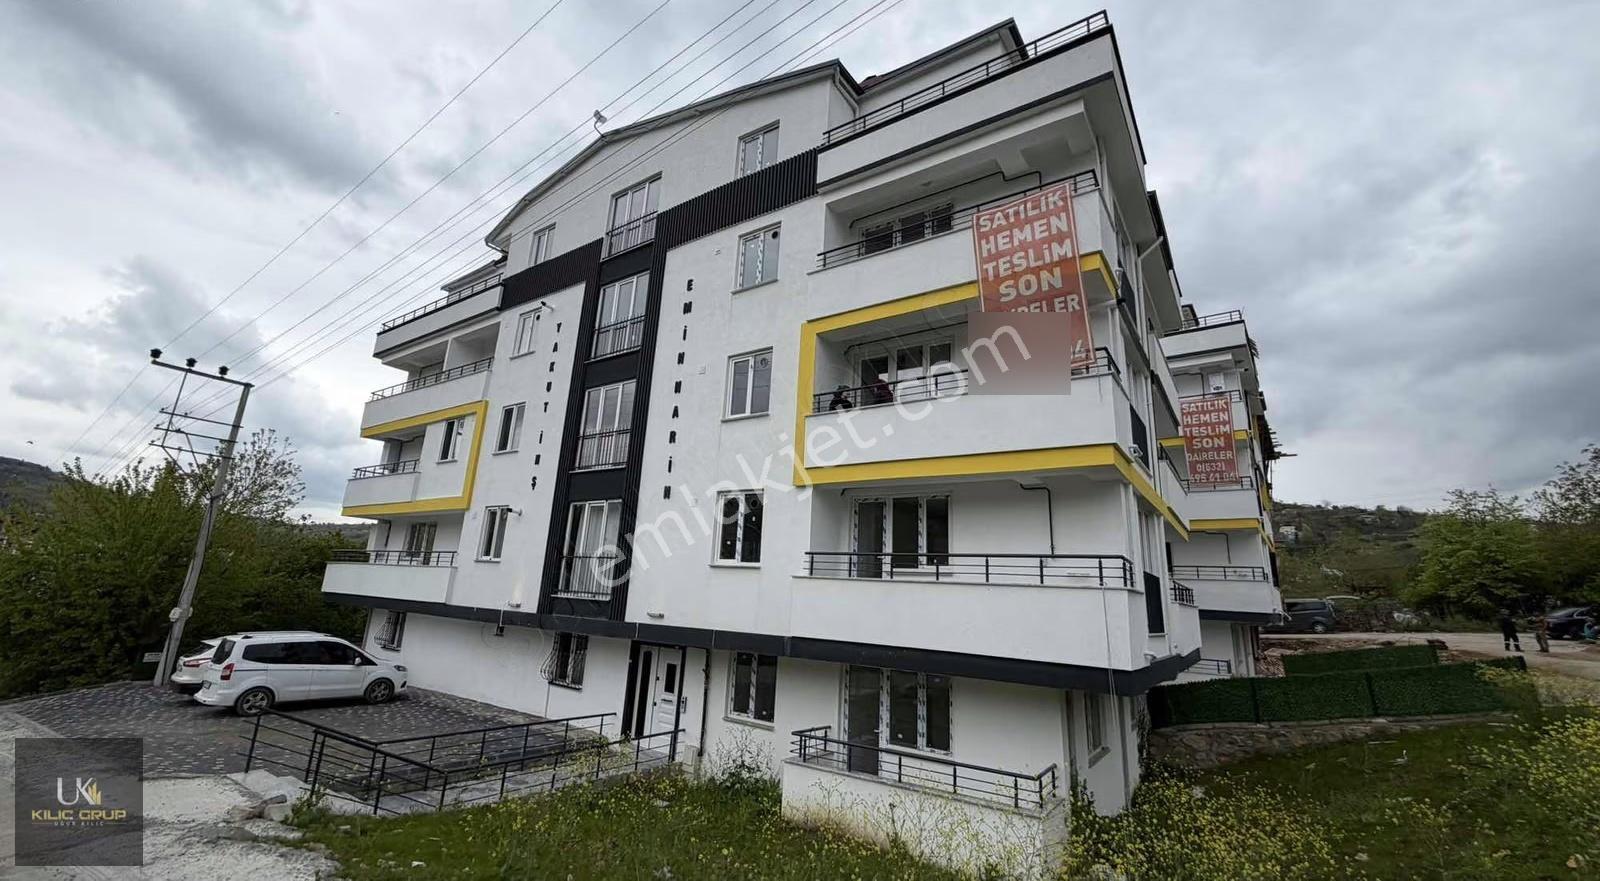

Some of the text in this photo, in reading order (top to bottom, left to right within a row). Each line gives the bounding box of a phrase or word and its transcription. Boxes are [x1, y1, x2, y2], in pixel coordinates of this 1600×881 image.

[979, 189, 1064, 233] SATILIK
[981, 212, 1069, 257] HEMEN
[983, 238, 1073, 282] TESLİM
[1000, 267, 1063, 303] SON
[1182, 400, 1227, 413] SATILIK
[1183, 411, 1229, 426] HEMEN
[1184, 424, 1230, 437] TESLİM
[1192, 437, 1225, 449] SON
